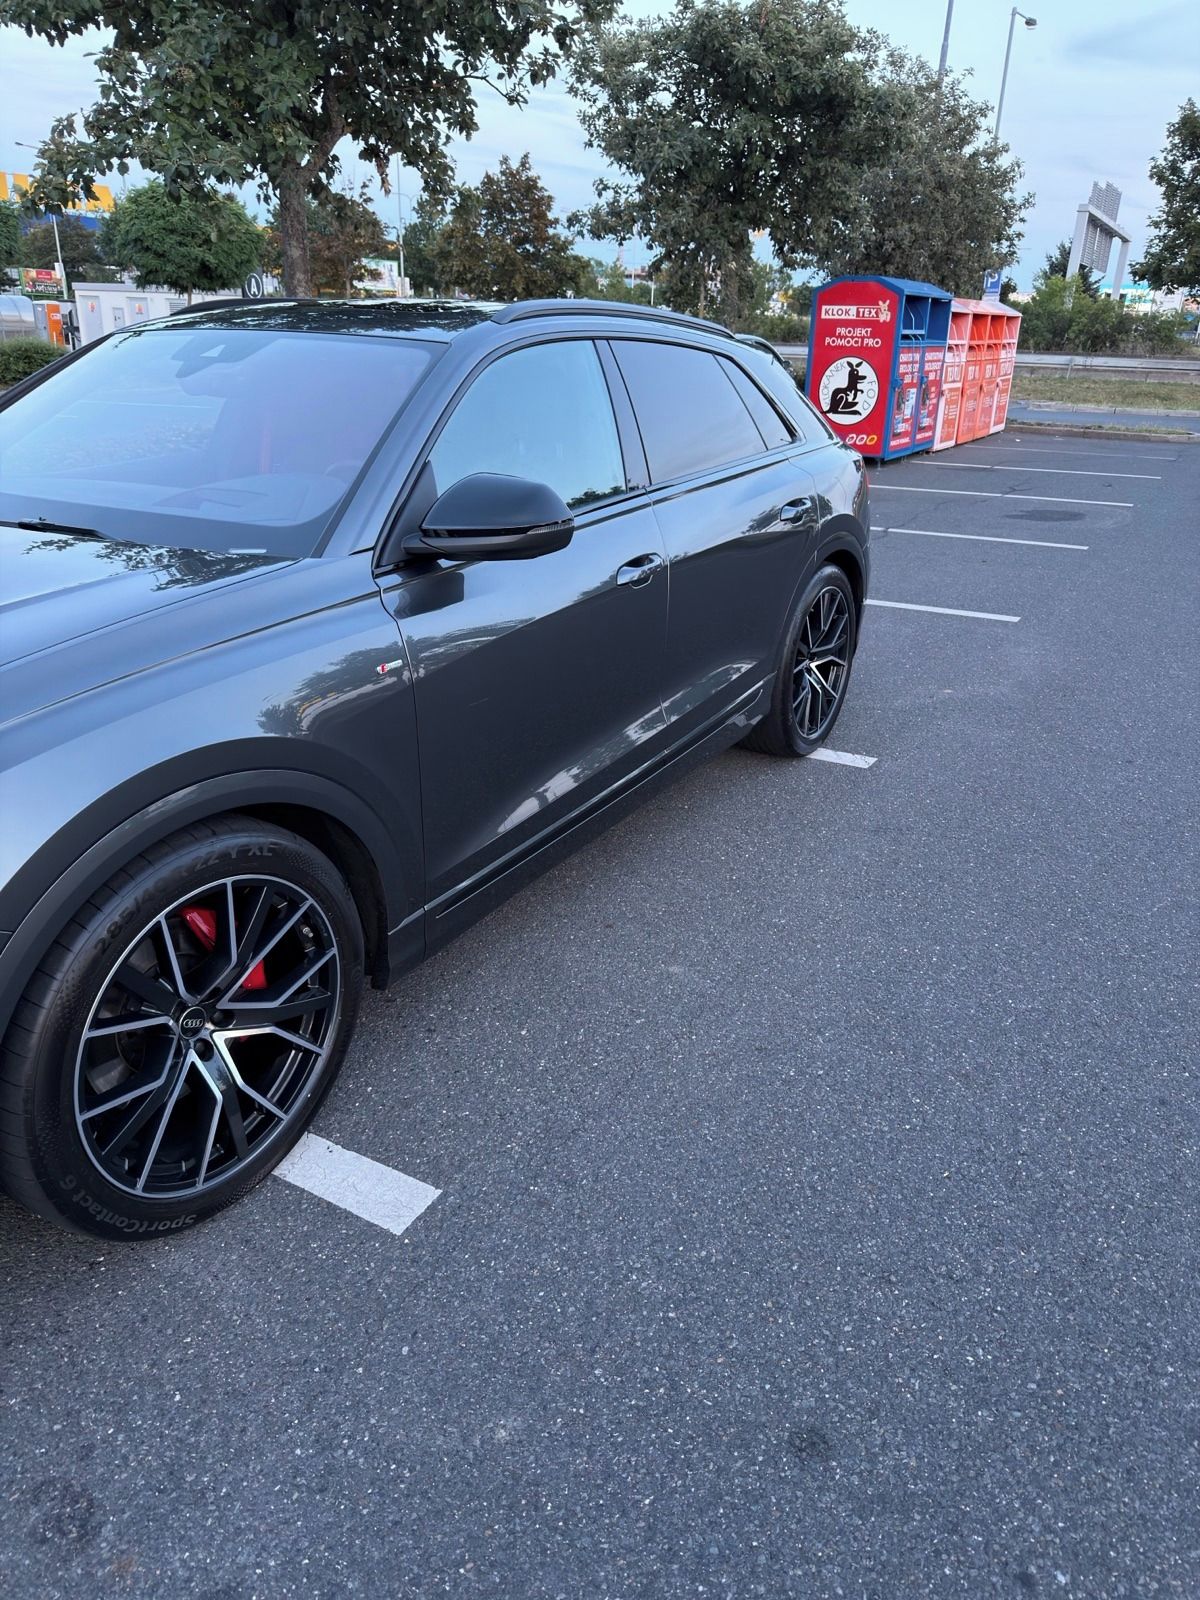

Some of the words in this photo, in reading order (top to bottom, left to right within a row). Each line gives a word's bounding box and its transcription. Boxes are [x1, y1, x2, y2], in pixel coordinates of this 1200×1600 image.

[251, 278, 258, 295] A
[835, 327, 872, 337] PROJEKT
[863, 338, 882, 348] PRO
[862, 380, 877, 411] FOD
[60, 1174, 77, 1190] 6
[77, 1189, 198, 1232] SportContact
